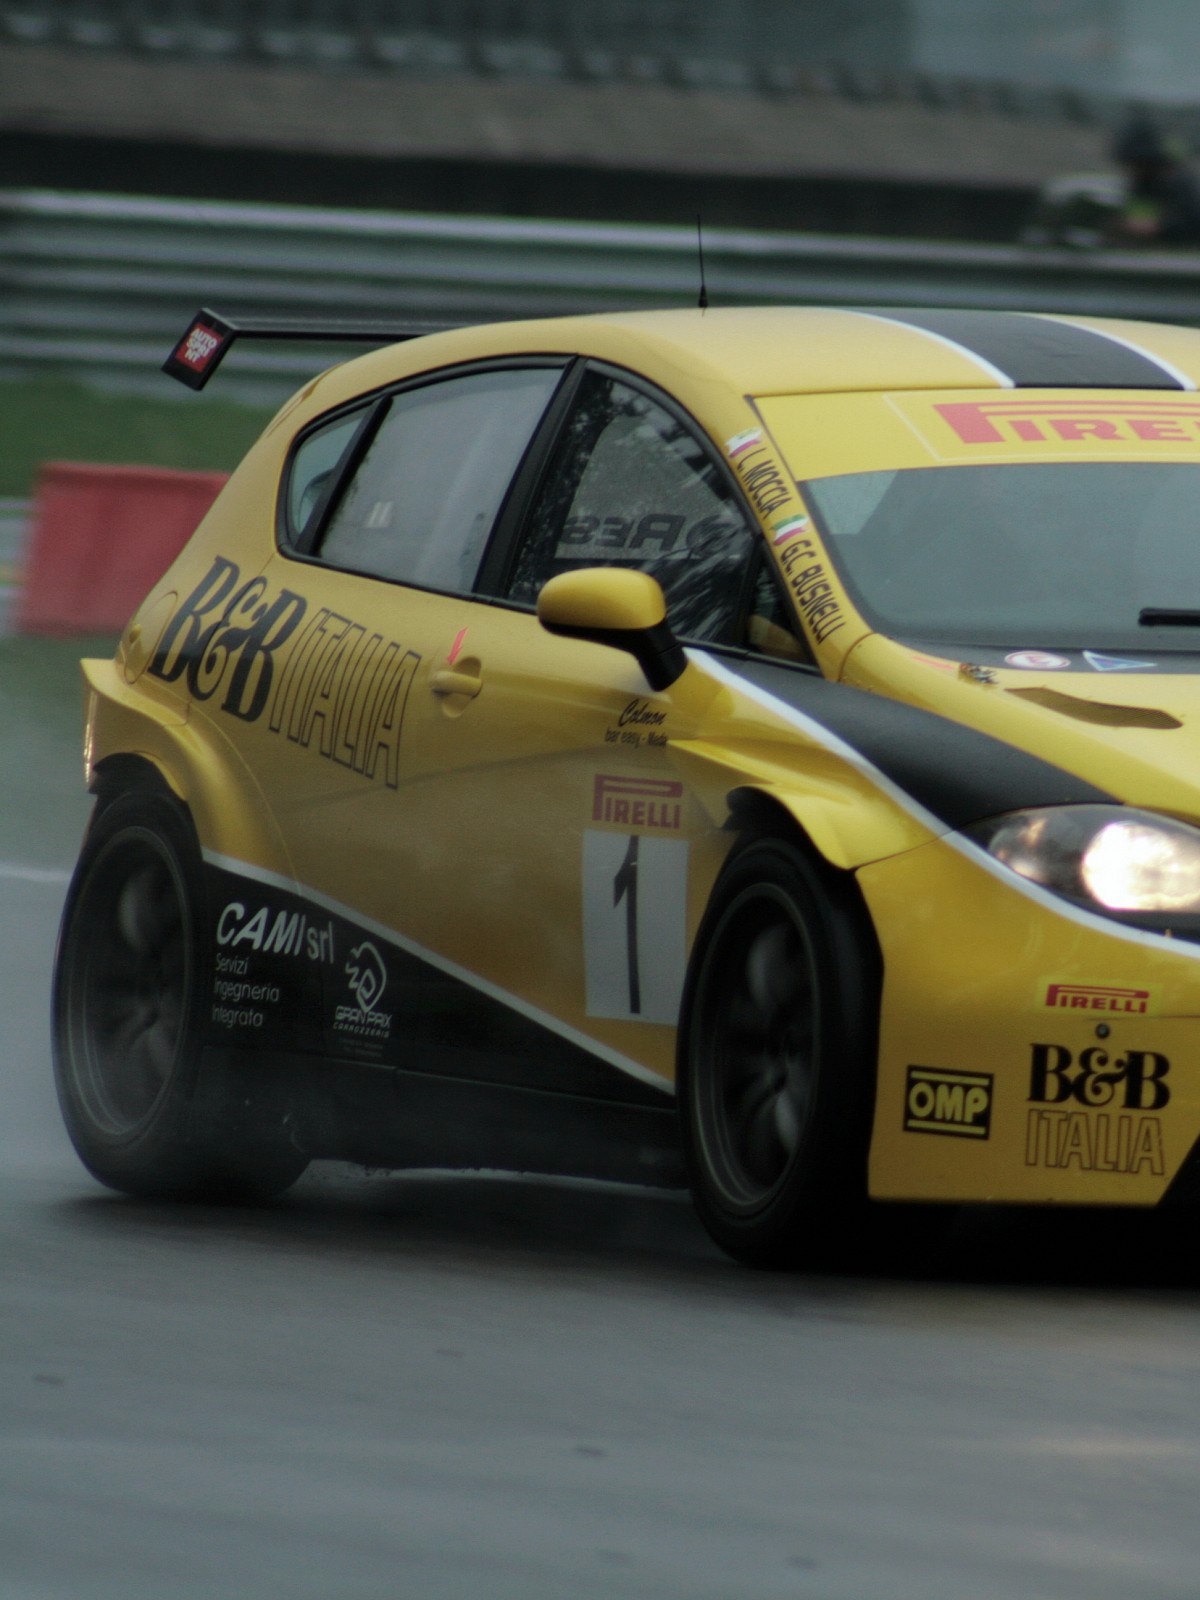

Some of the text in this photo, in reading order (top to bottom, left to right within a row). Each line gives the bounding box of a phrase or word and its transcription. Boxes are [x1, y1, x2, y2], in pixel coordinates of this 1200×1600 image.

[191, 328, 217, 348] AUTO
[744, 459, 793, 520] MOCCIA
[147, 555, 422, 790] B&B ITALIA
[592, 774, 683, 829] PIRELLI
[217, 903, 334, 964] CAMI srl
[613, 834, 641, 1014] 1
[213, 977, 280, 1002] Ingegneria
[214, 953, 249, 975] Servizi
[211, 1005, 264, 1029] Integrata
[1045, 984, 1150, 1013] PIRELLI
[908, 1082, 989, 1124] OMP
[1027, 1043, 1171, 1111] B&B
[1025, 1108, 1165, 1176] ITALIA
